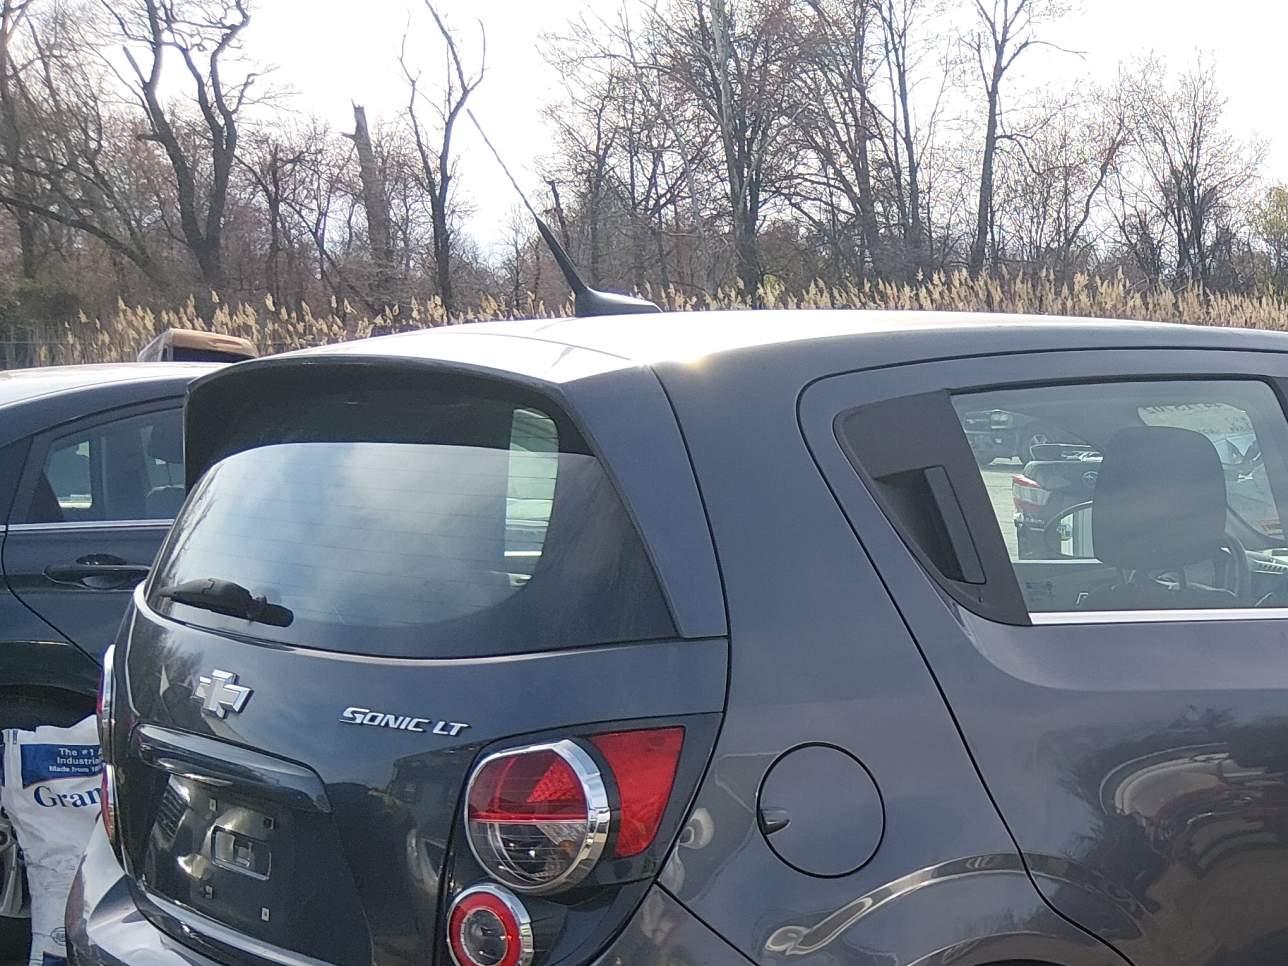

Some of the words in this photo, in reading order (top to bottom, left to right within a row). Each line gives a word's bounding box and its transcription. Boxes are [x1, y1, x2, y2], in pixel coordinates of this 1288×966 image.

[339, 706, 431, 732] SONIC
[432, 720, 470, 736] LT
[58, 747, 78, 756] The
